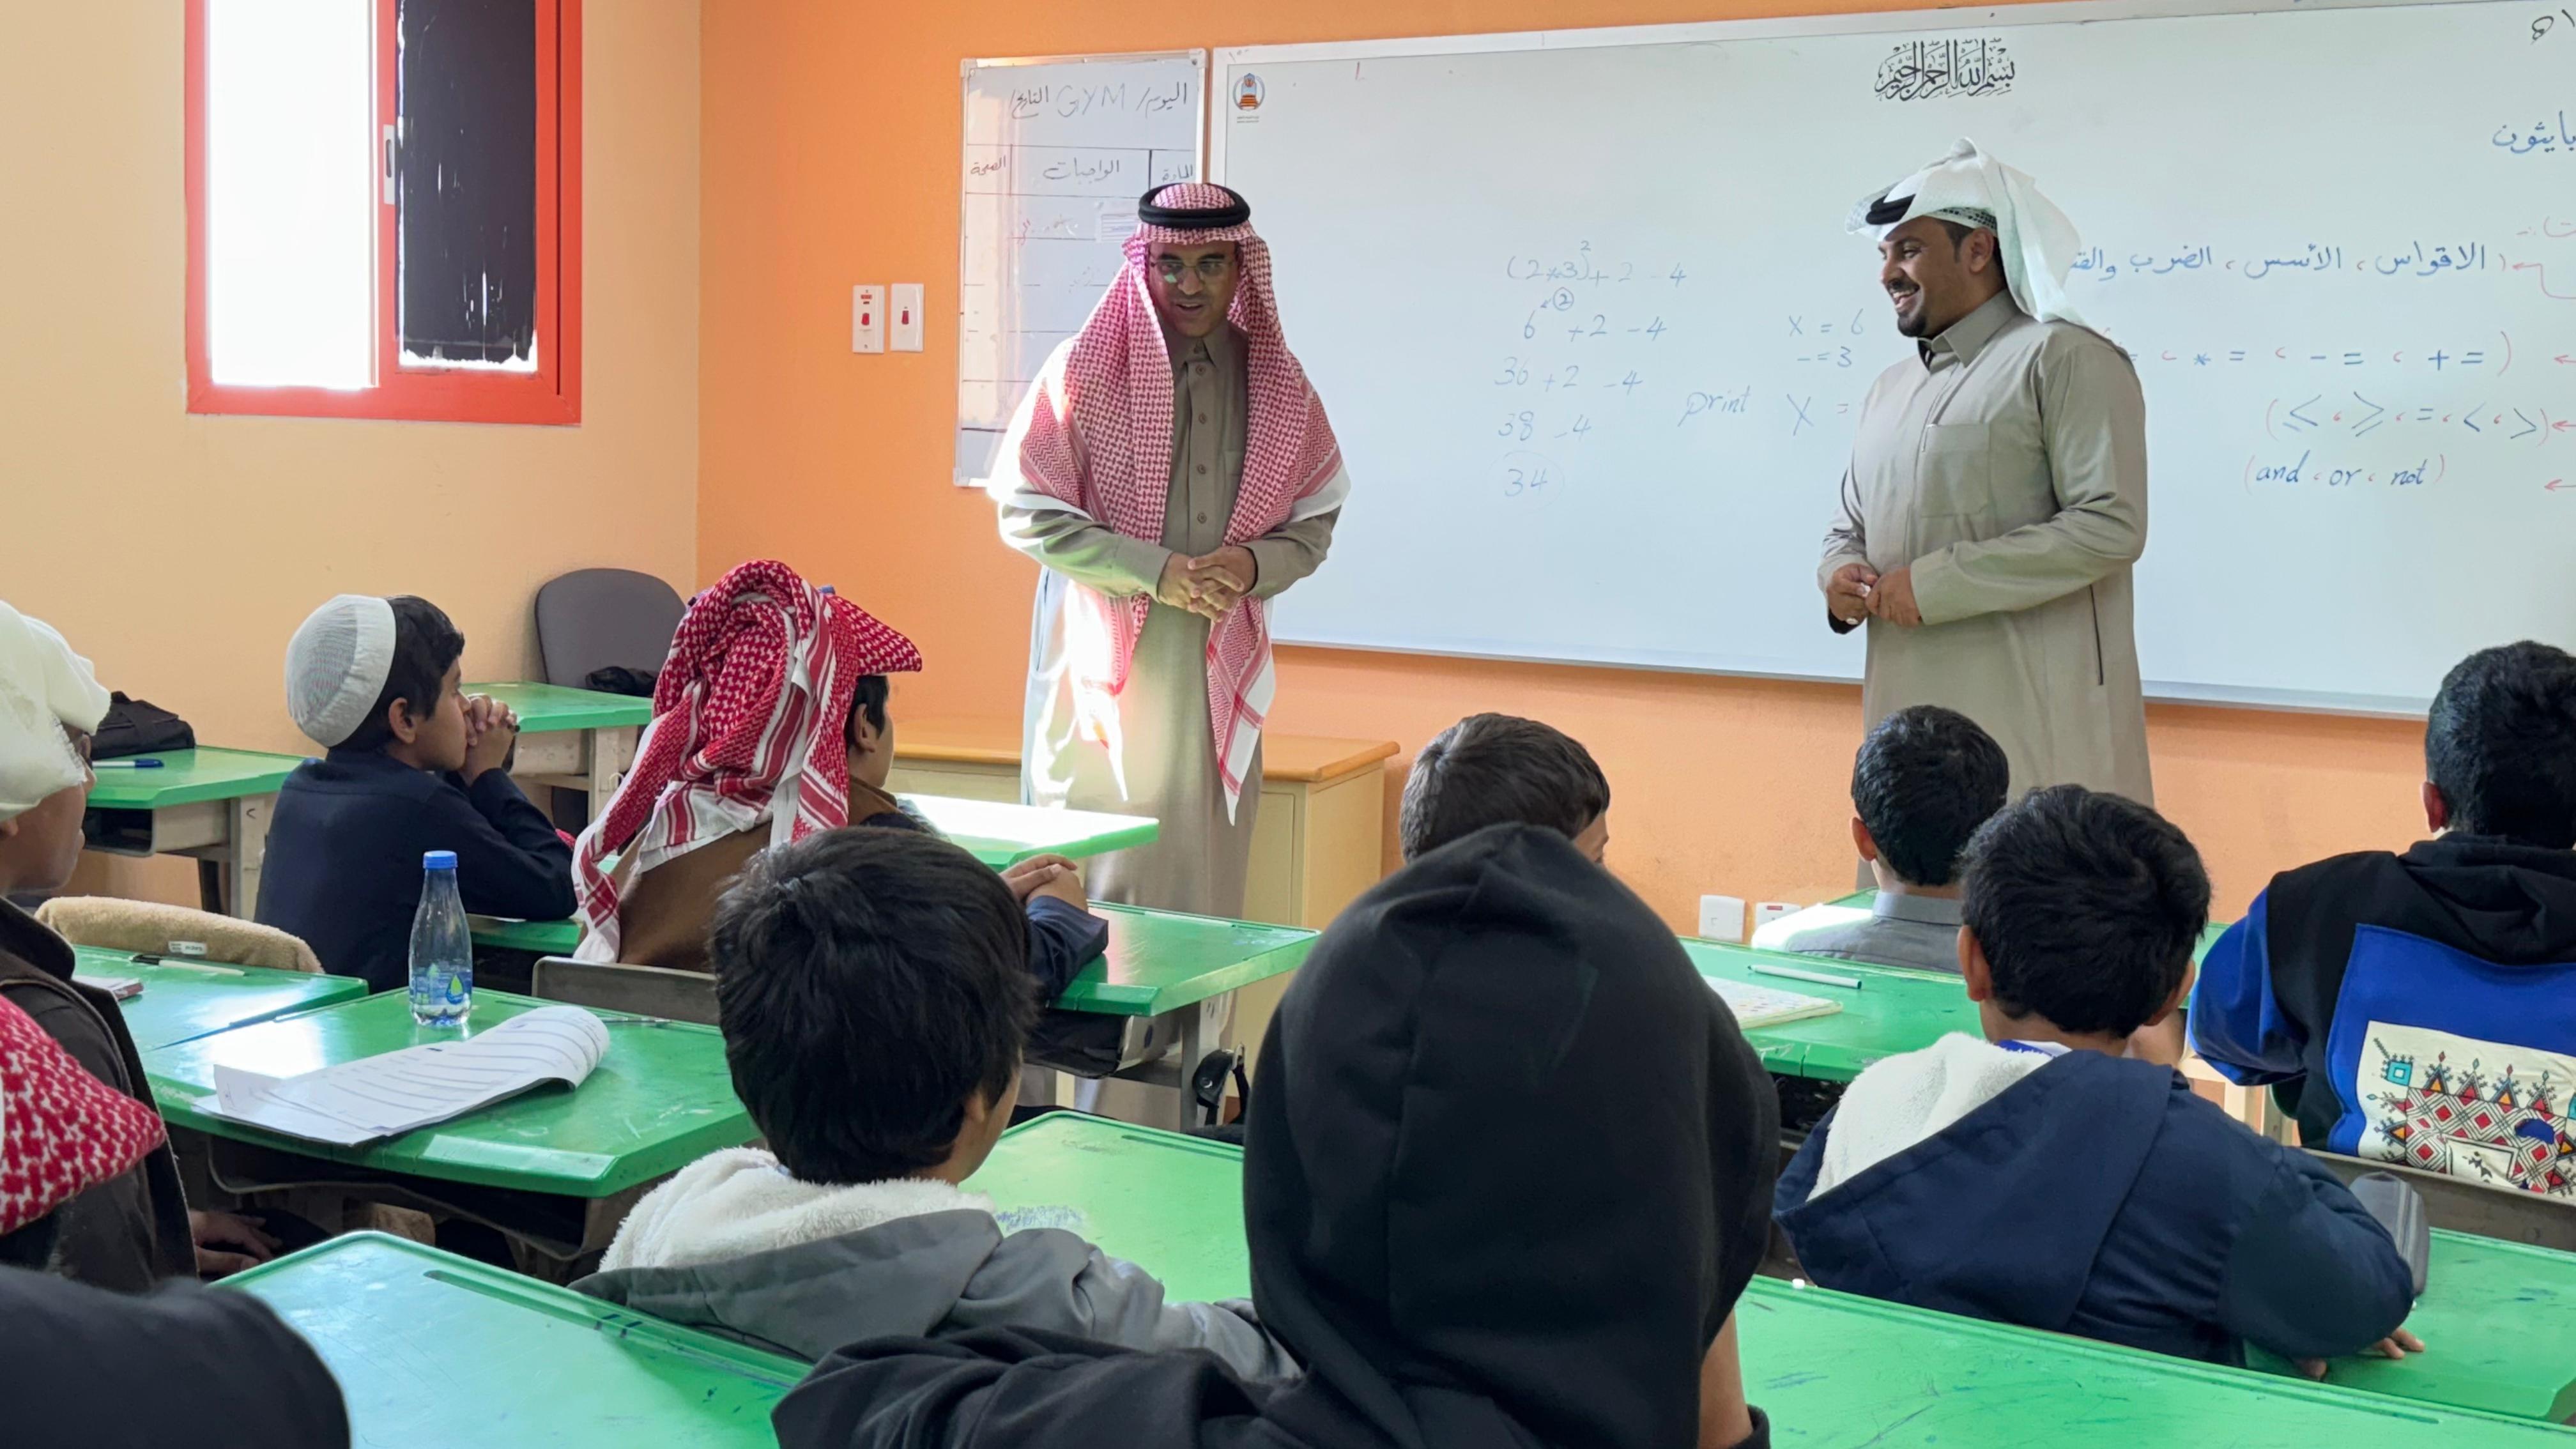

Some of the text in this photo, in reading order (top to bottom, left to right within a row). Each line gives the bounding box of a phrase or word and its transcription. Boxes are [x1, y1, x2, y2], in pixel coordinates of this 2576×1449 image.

[1057, 82, 1125, 118] GYM
[1042, 157, 1120, 185] الواجبات
[1676, 385, 1752, 428] print
